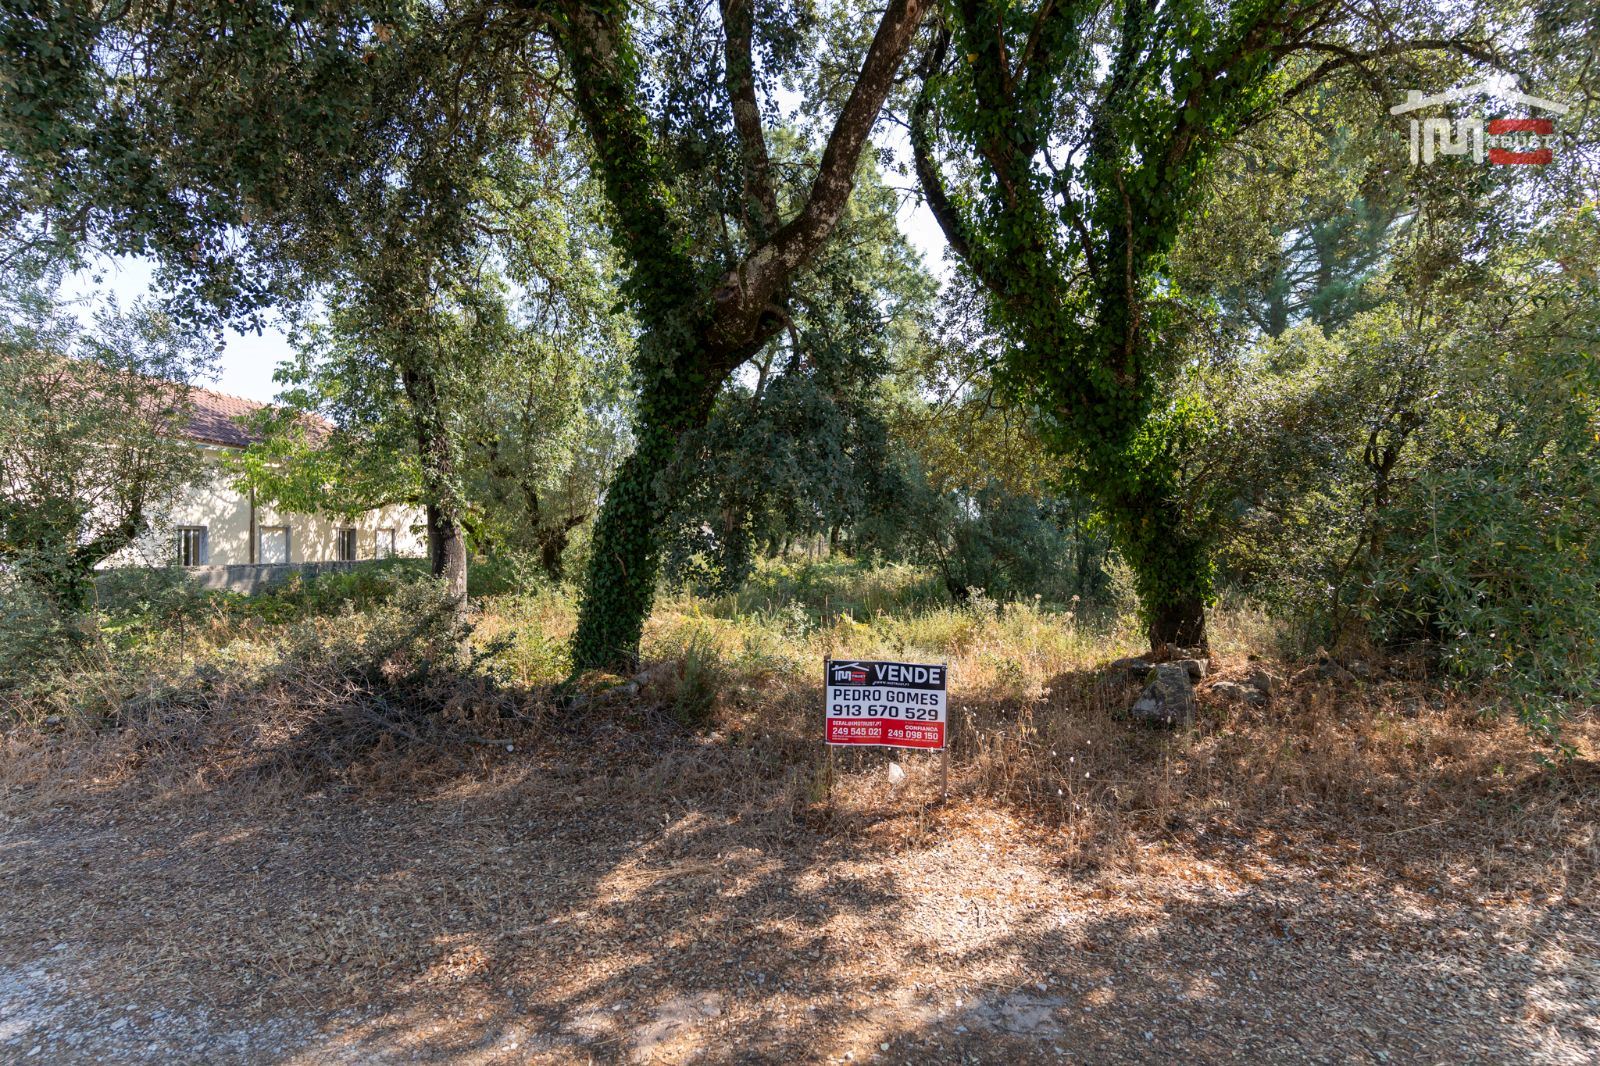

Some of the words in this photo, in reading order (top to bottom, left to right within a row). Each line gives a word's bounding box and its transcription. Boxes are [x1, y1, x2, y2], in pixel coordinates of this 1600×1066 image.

[875, 664, 940, 684] VENDE
[833, 689, 881, 701] PEDRO
[887, 690, 939, 705] GOMES
[832, 704, 862, 717] 913
[867, 705, 899, 718] 670
[905, 707, 939, 721] 529
[832, 727, 849, 735] 249
[850, 727, 866, 736] 545
[868, 727, 882, 736] 021
[887, 729, 904, 737] 249
[905, 730, 923, 739] 098
[924, 732, 939, 740] 150
